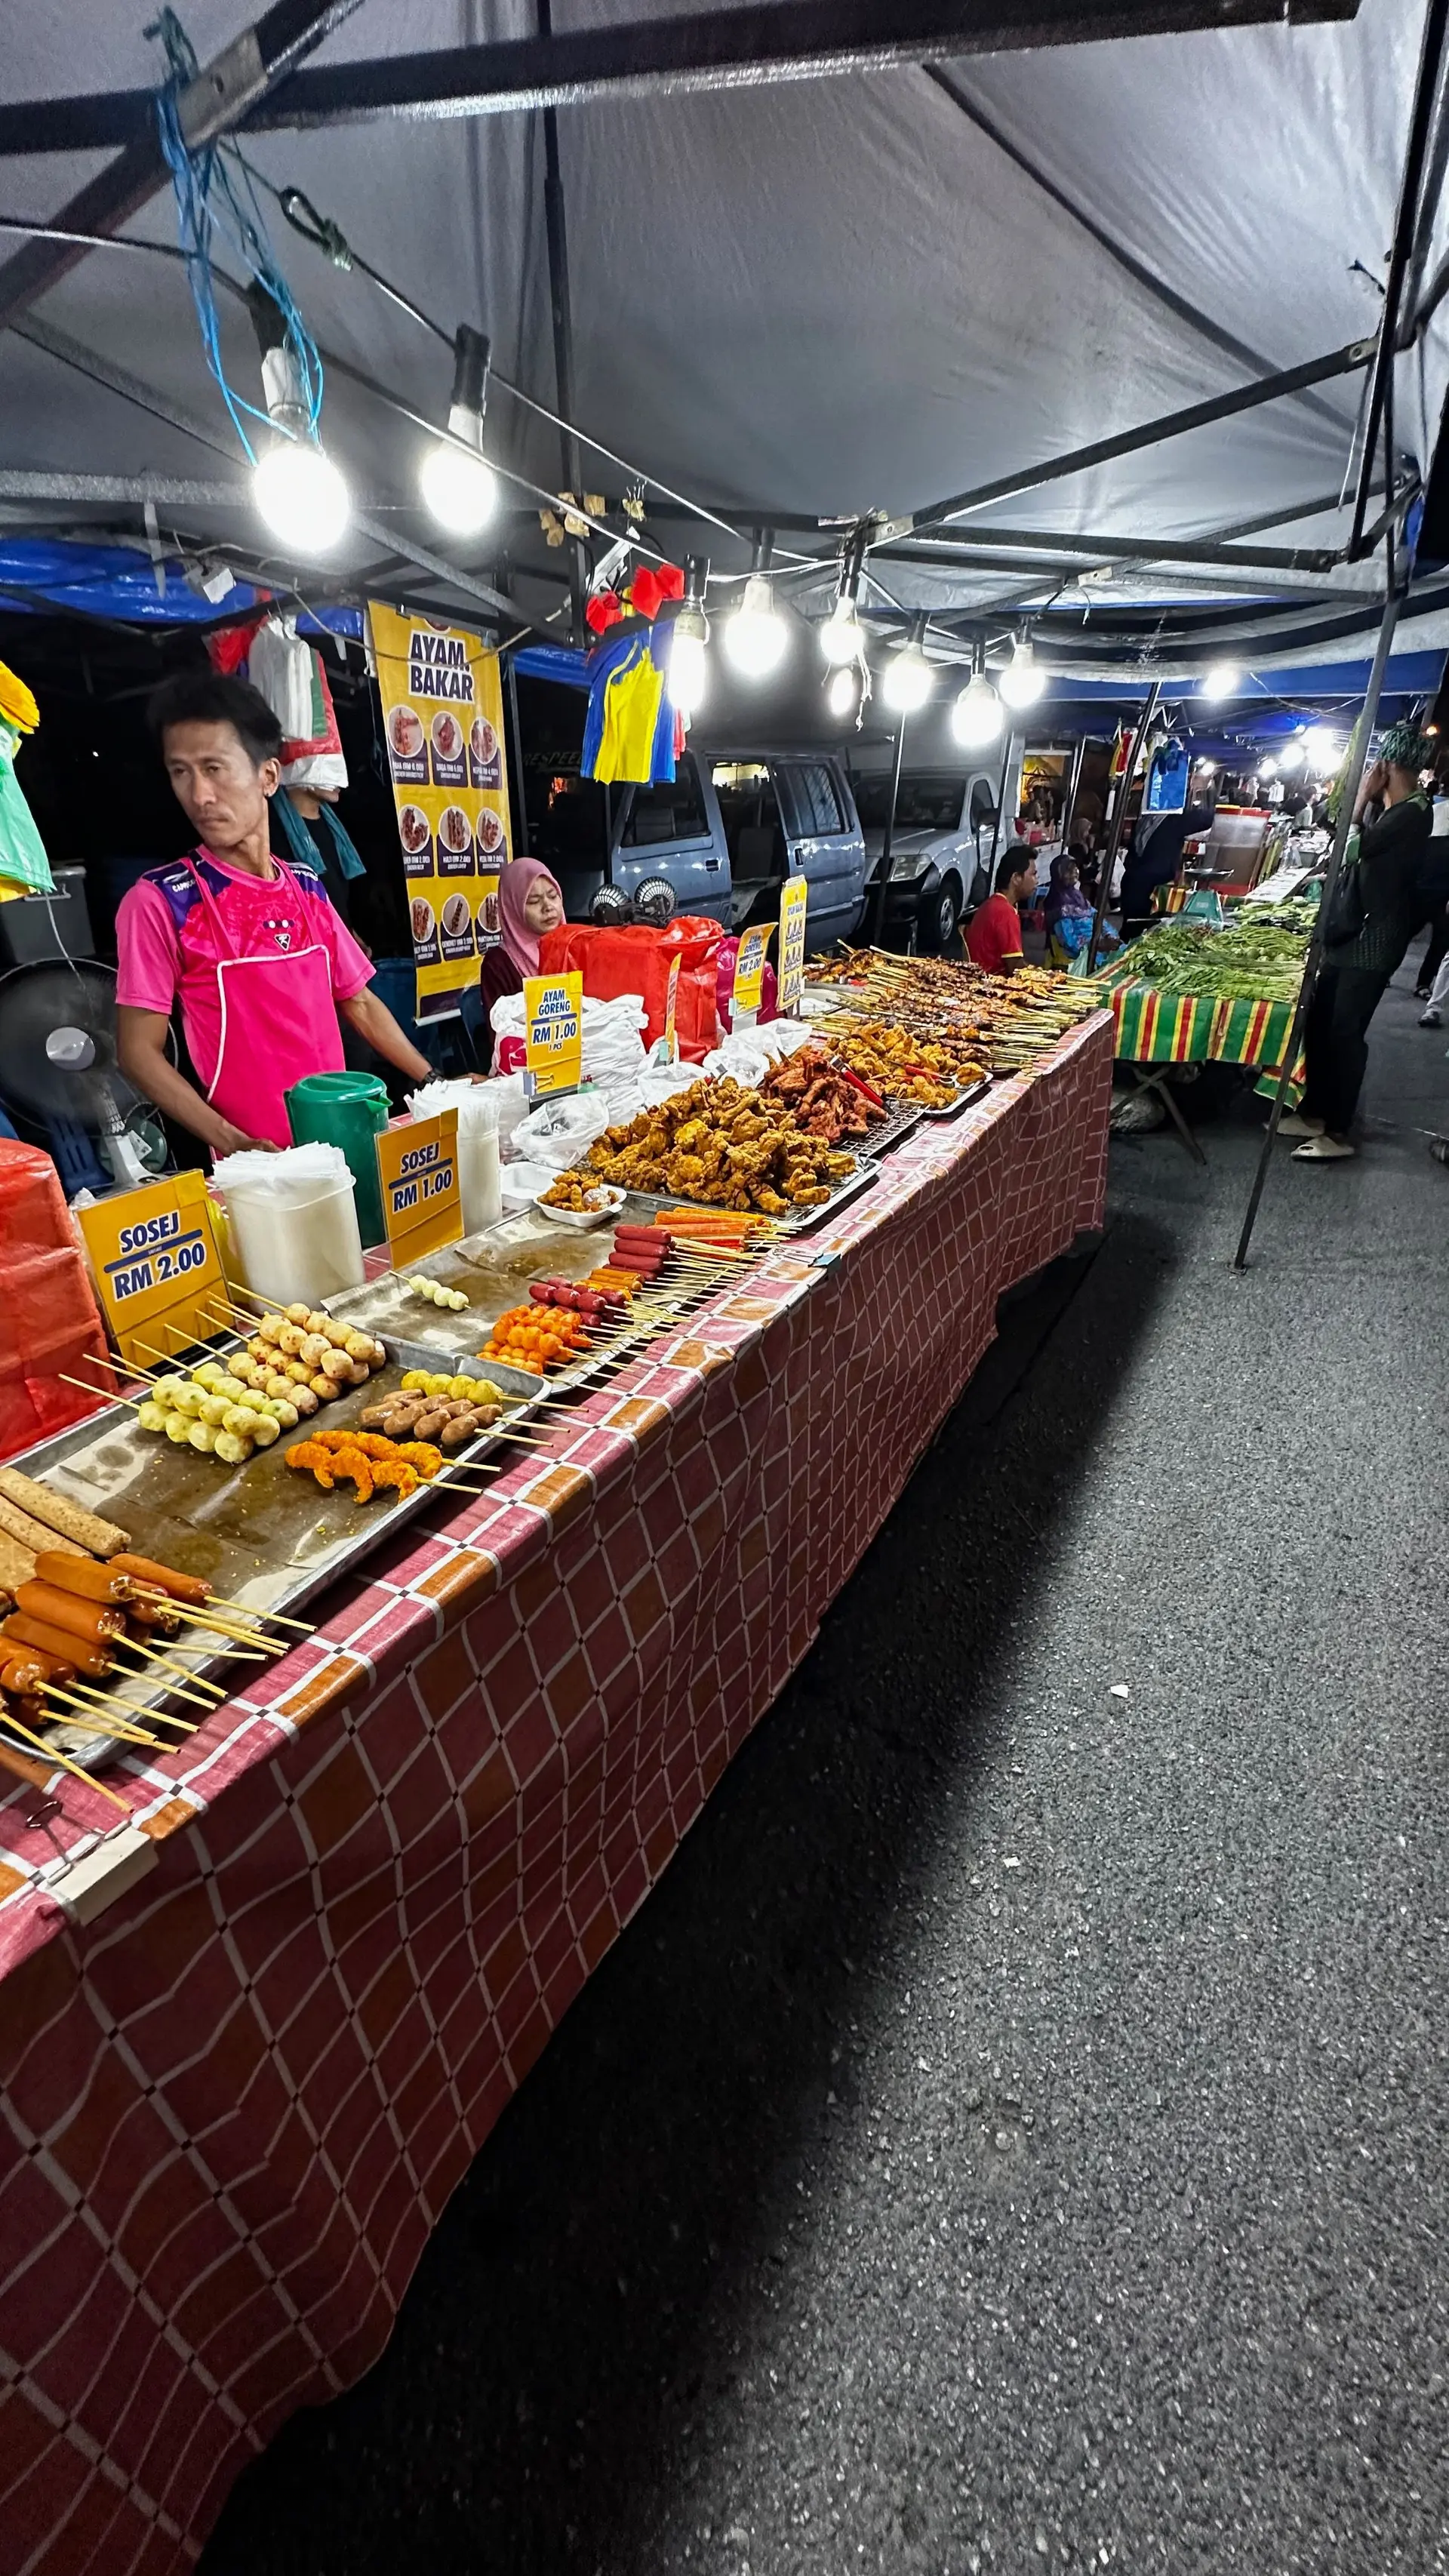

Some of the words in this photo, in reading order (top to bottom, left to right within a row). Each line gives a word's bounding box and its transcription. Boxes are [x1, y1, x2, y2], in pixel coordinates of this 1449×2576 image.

[411, 665, 473, 701] BAKAR
[739, 962, 748, 974] RM
[749, 956, 761, 971] 2.00
[539, 1001, 571, 1016] GORENG
[543, 989, 565, 1003] AYAM
[533, 1026, 550, 1044] RM
[555, 1022, 576, 1040] 1.00
[401, 1141, 439, 1174] SOSEJ
[393, 1183, 417, 1212] RM
[423, 1169, 452, 1199] 1.00
[120, 1211, 179, 1253] SOSEJ
[114, 1263, 153, 1299] RM
[157, 1242, 205, 1282] 2.00
